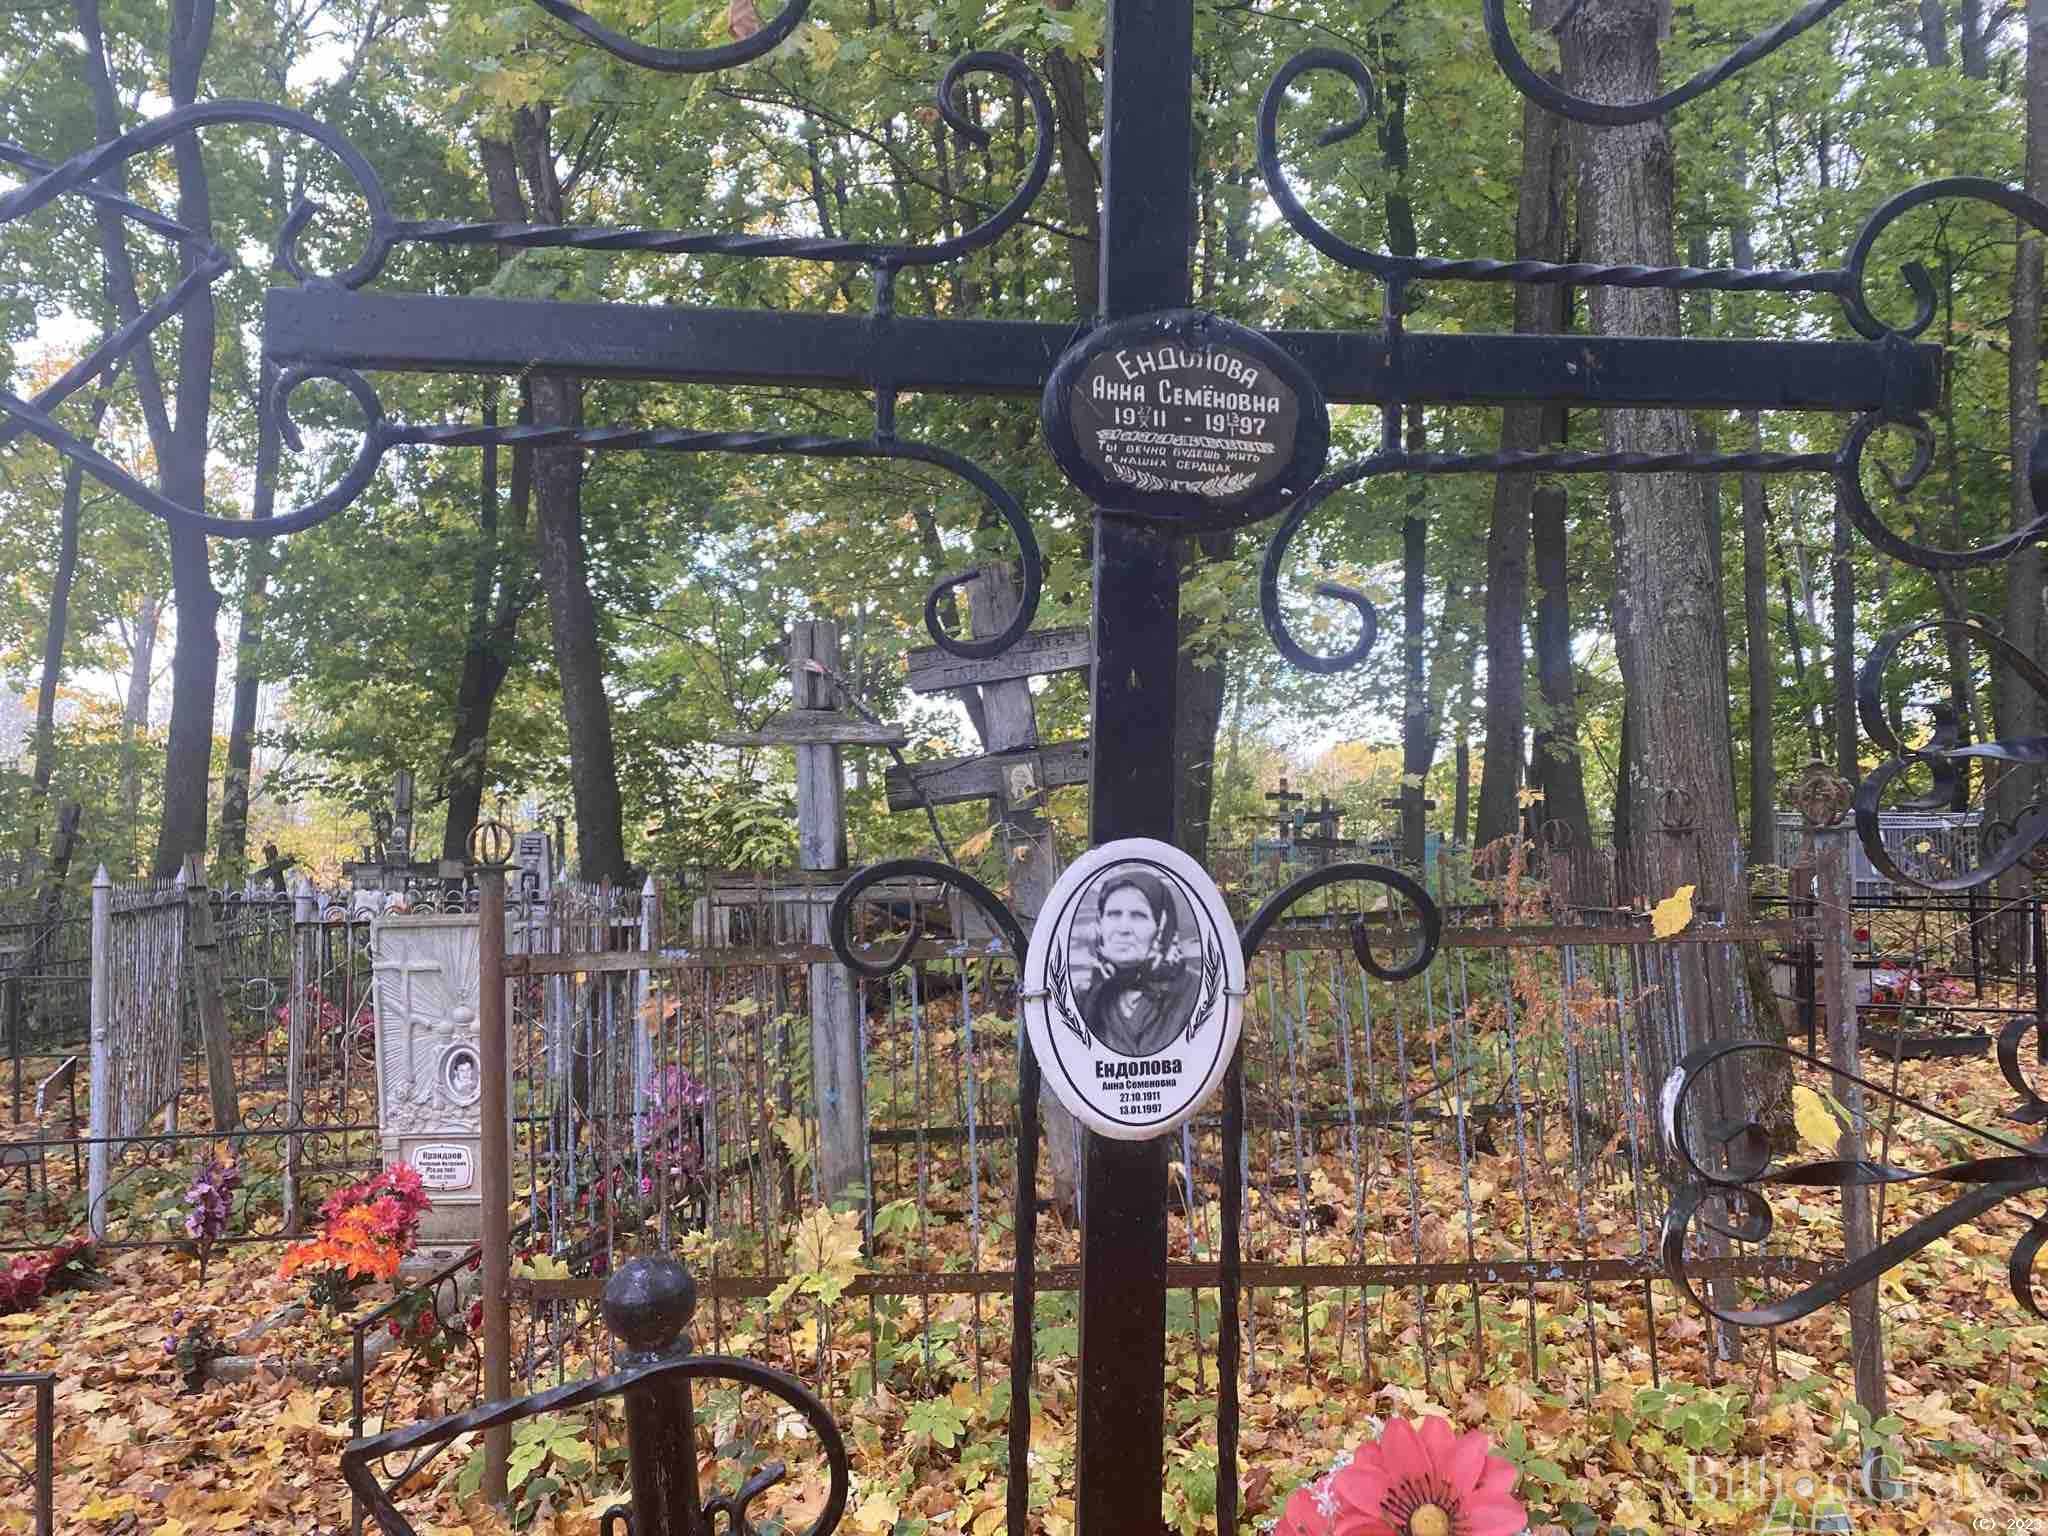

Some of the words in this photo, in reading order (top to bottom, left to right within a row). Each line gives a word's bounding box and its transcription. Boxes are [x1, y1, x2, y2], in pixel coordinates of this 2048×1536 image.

[1092, 375, 1146, 402] АННА
[1159, 379, 1281, 413] СЕМЁНОВНА
[1095, 1058, 1183, 1079] Ендолова
[1102, 1081, 1125, 1091] Анна
[1119, 1091, 1161, 1102] 27.10.1911
[1119, 1103, 1162, 1115] 13.01.1997
